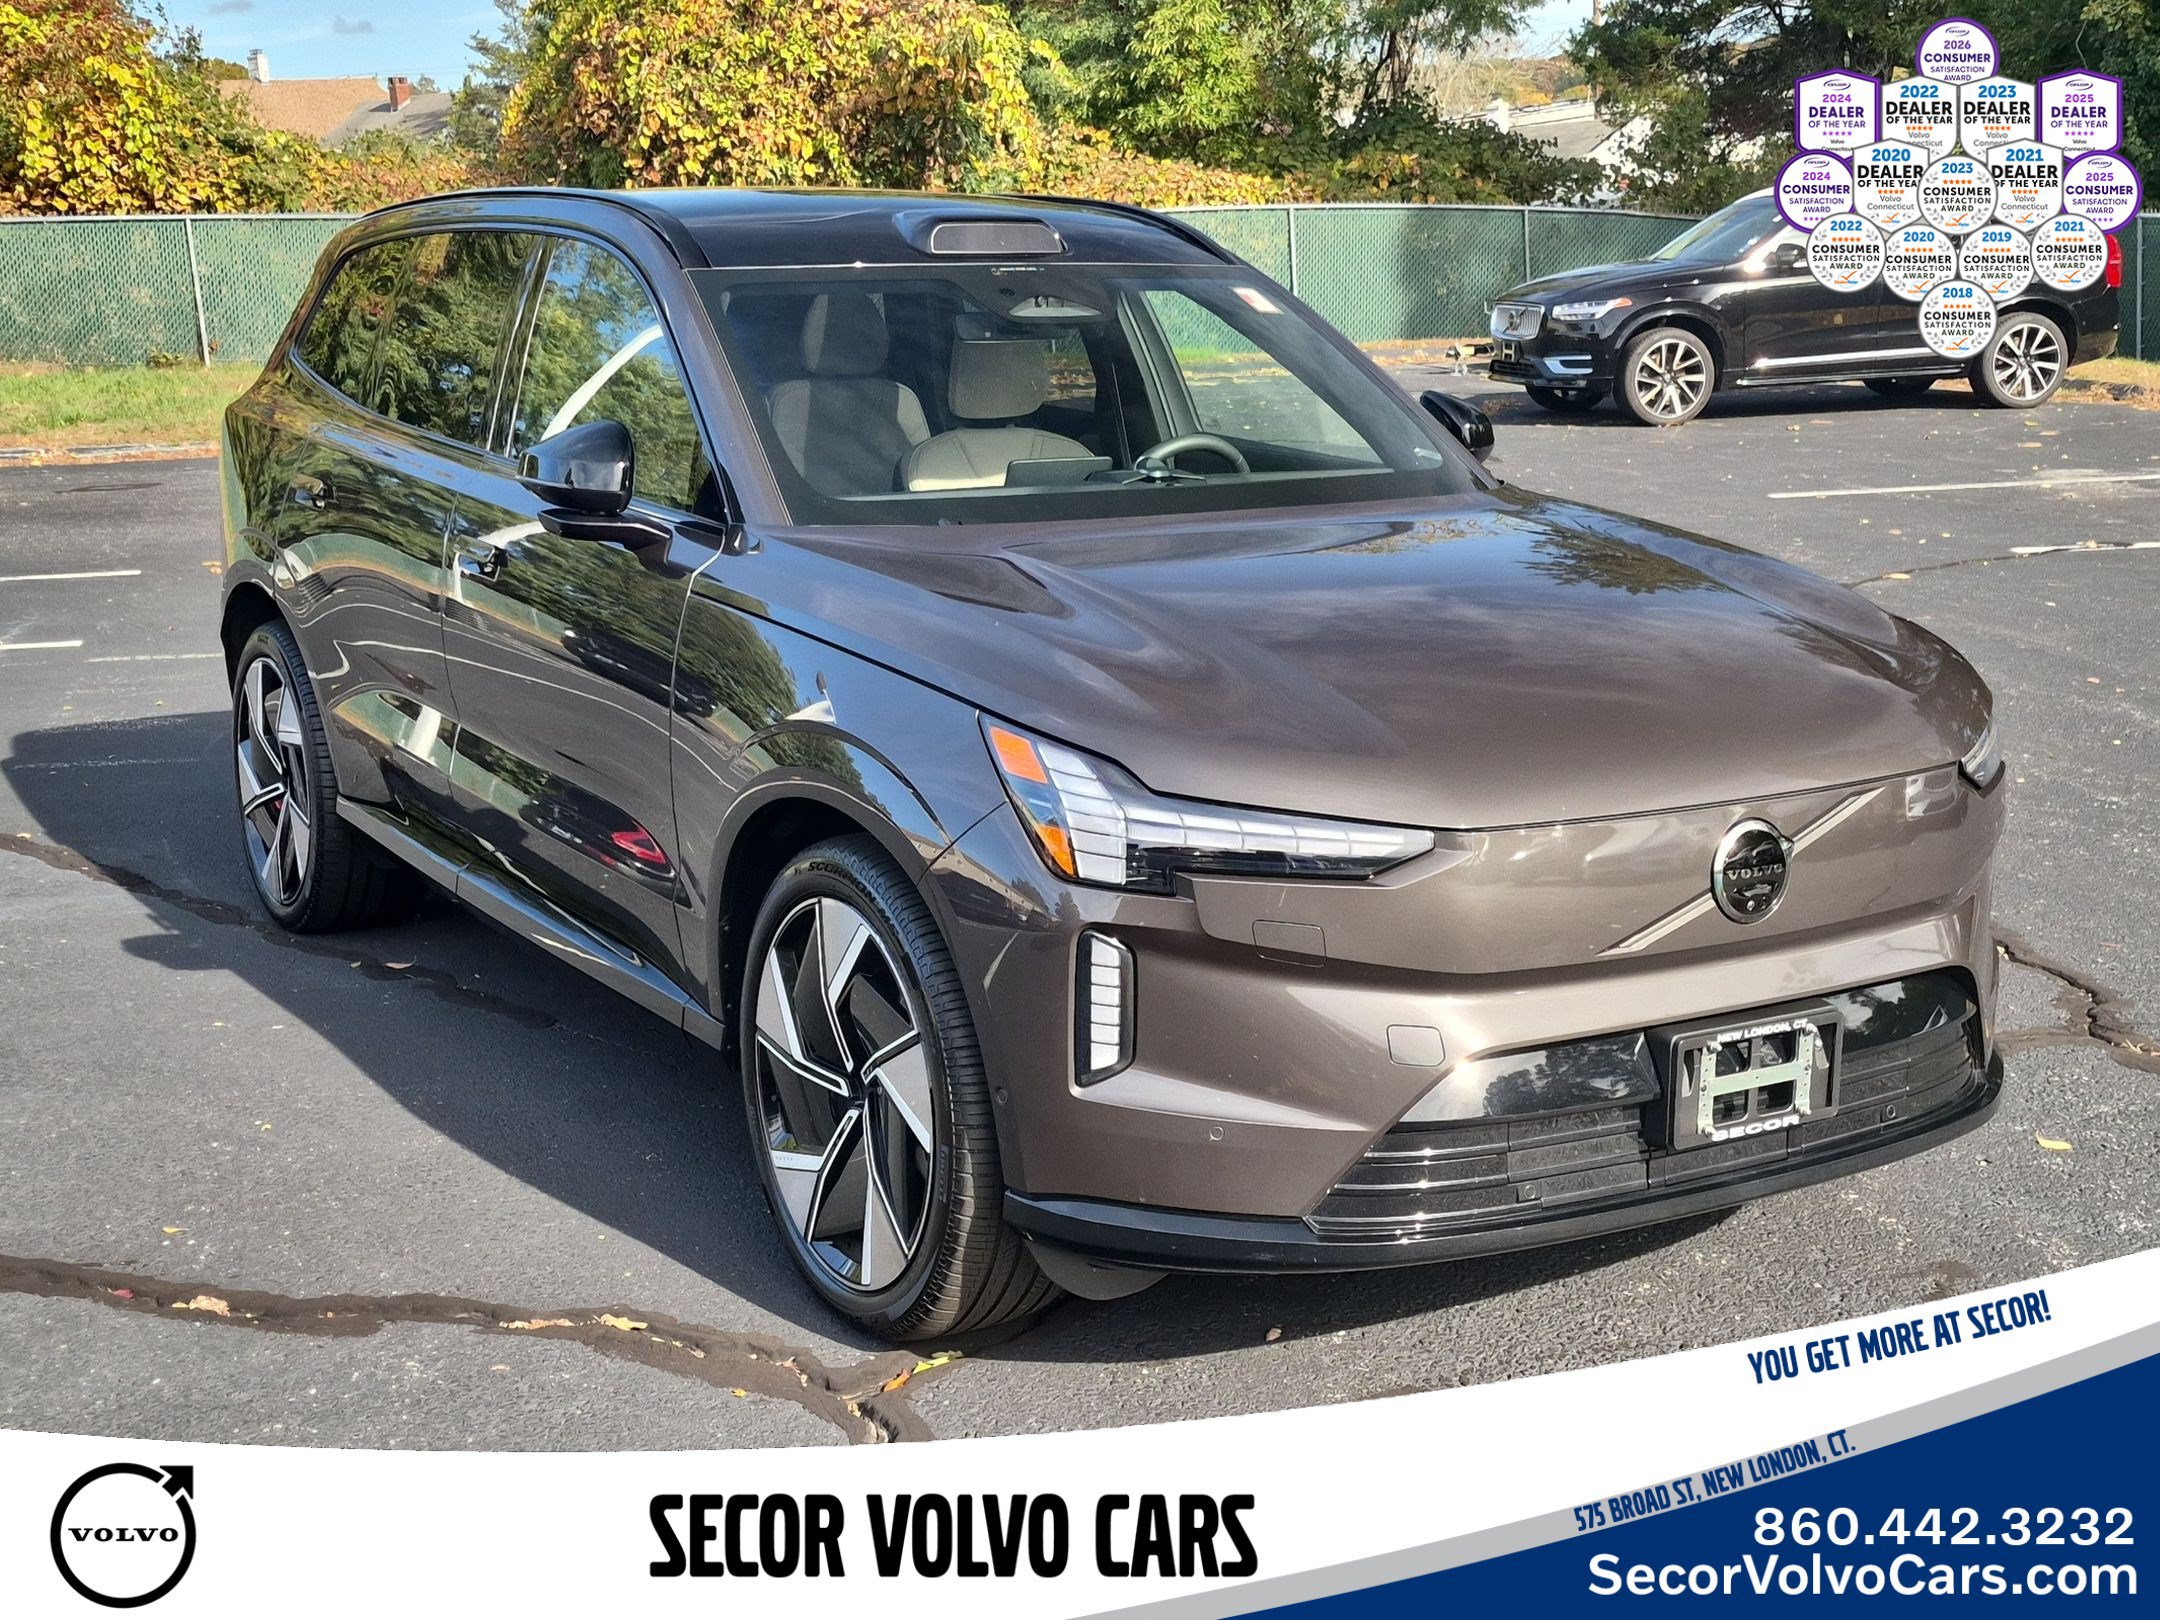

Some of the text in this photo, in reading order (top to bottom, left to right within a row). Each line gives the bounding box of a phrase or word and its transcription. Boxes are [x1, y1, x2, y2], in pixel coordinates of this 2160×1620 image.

[1725, 863, 1784, 880] VOLVO
[1717, 1031, 1743, 1043] NEW
[1712, 1114, 1800, 1142] SECOR
